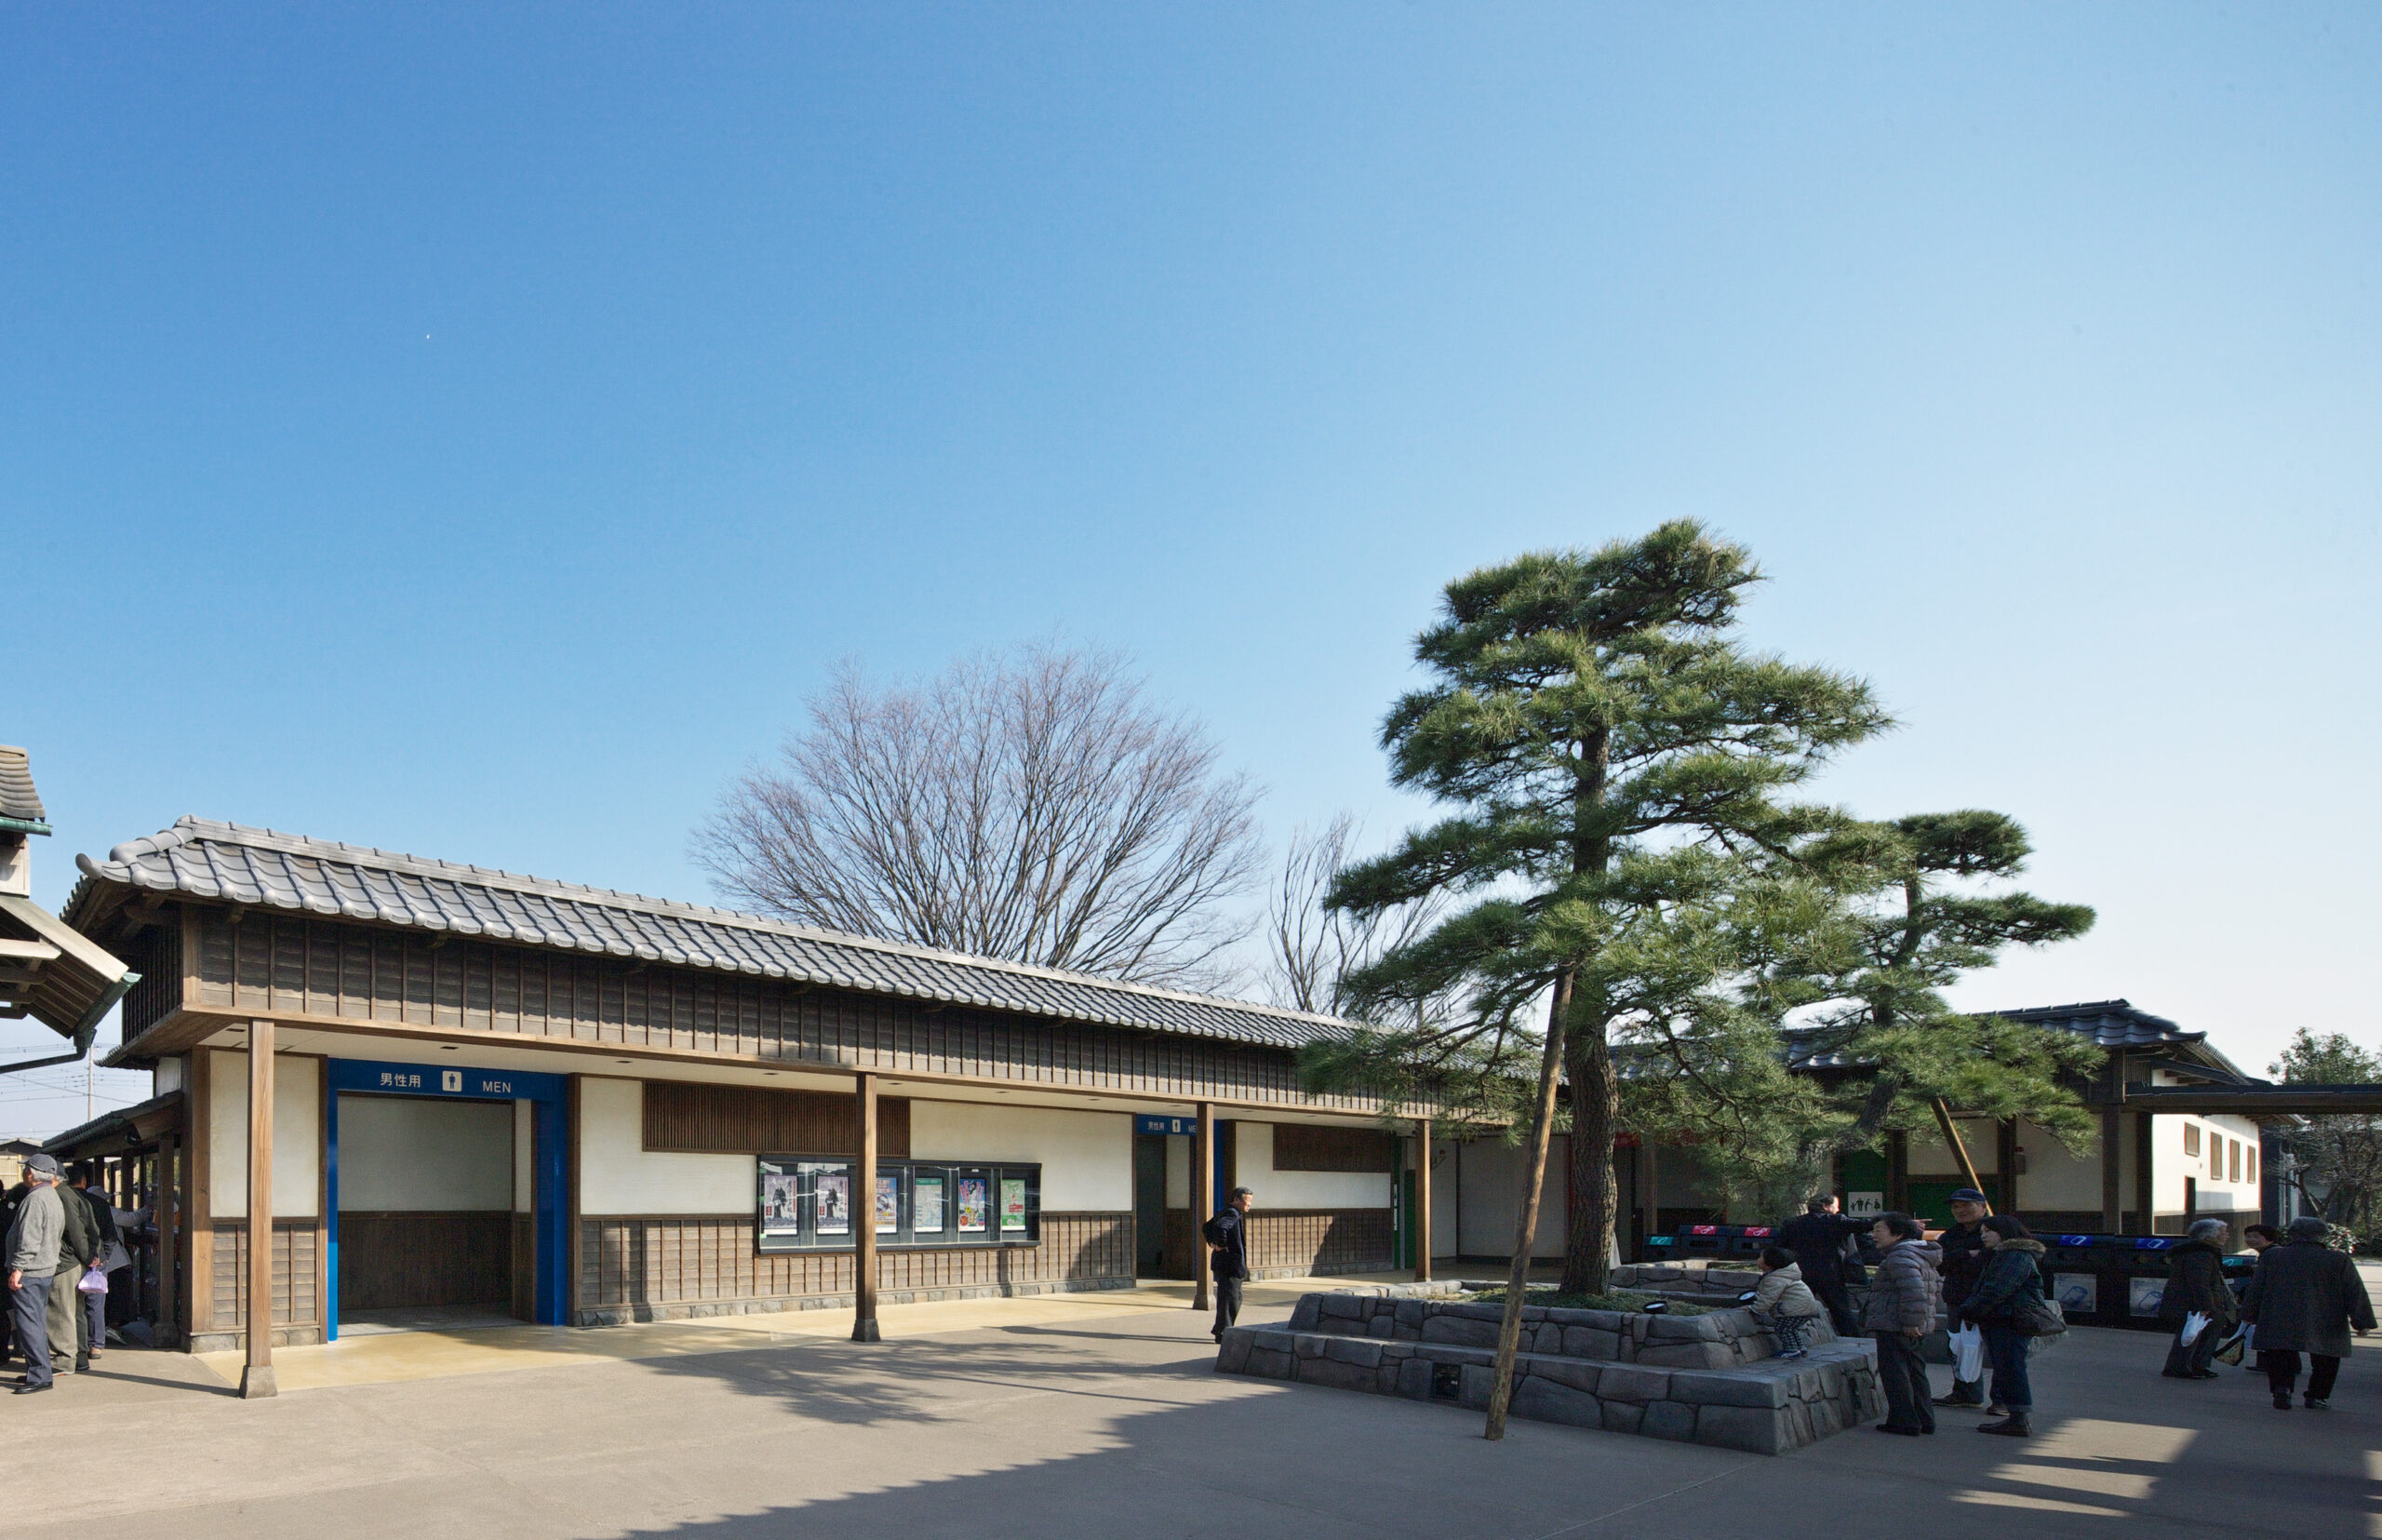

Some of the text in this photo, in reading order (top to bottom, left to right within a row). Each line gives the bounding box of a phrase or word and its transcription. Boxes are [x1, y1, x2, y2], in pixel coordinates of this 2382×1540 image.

[380, 1072, 421, 1088] 男性用
[483, 1080, 512, 1093] MEN
[1187, 1125, 1198, 1133] ME
